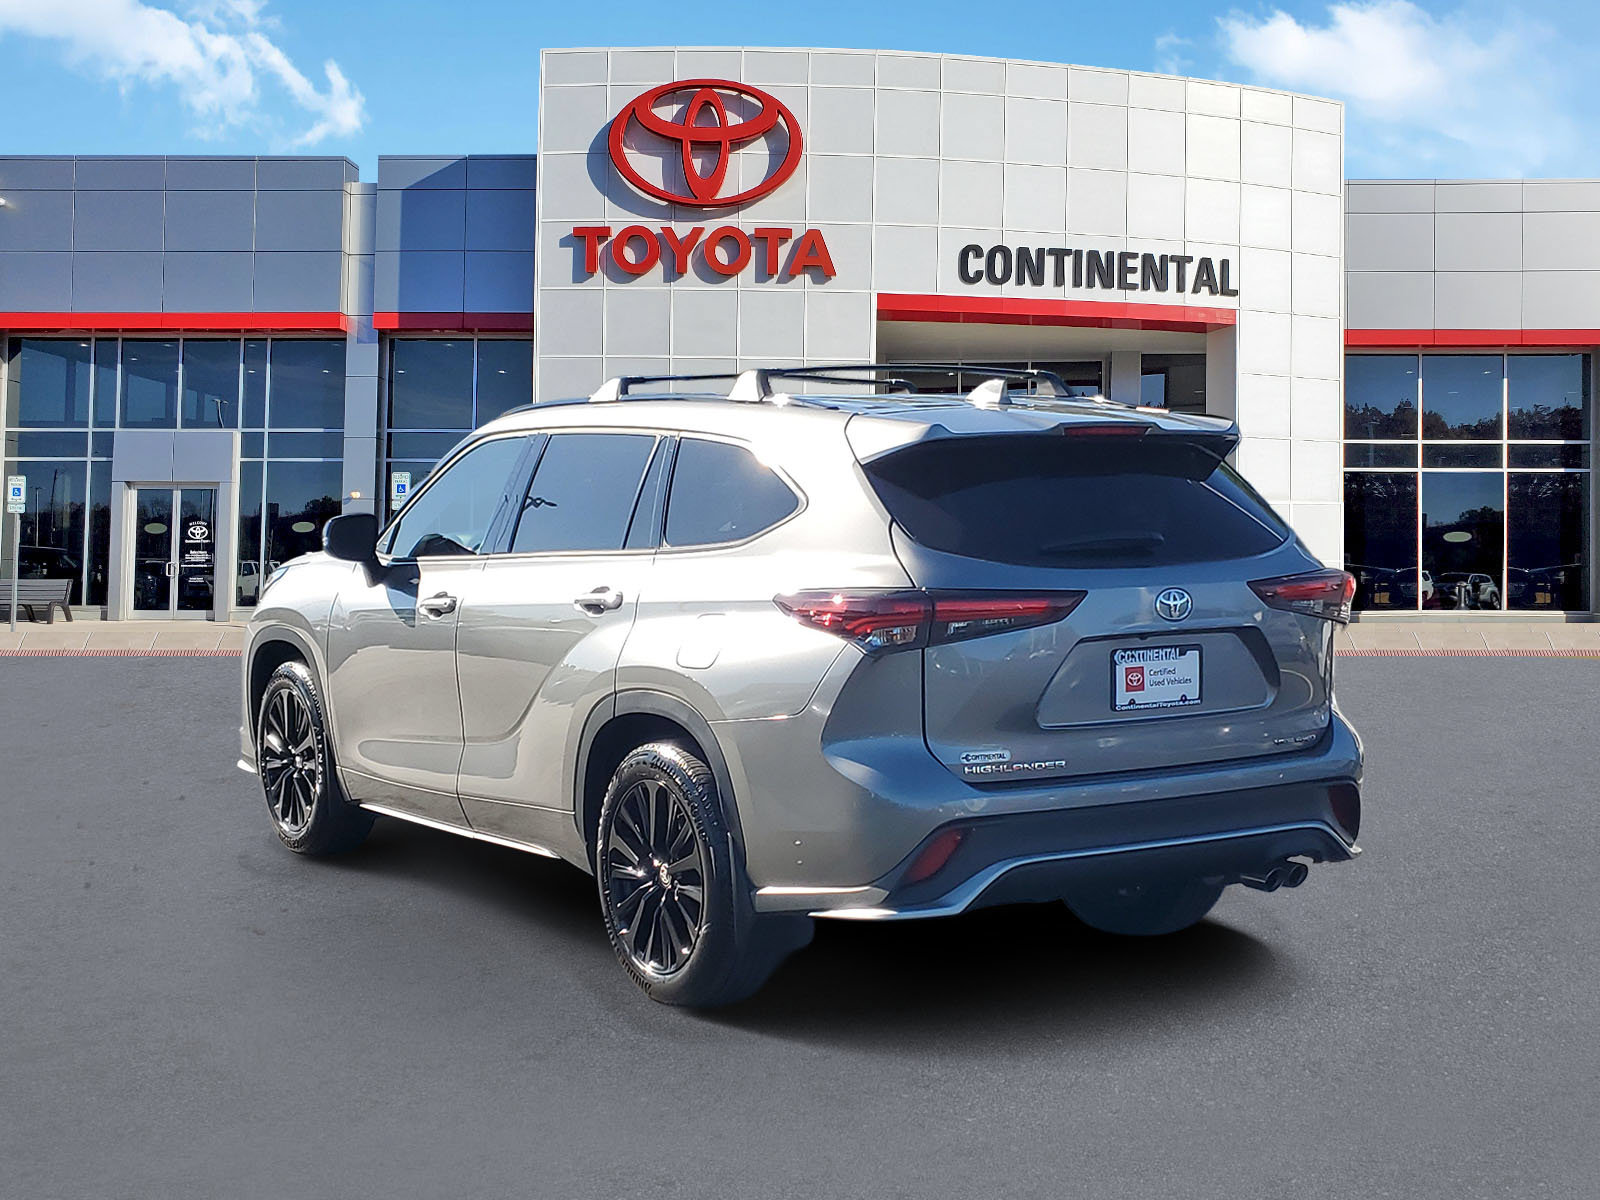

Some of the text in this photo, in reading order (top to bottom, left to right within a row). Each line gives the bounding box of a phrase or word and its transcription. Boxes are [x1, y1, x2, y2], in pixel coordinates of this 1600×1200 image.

[572, 226, 836, 278] TOYOTA
[959, 244, 1239, 297] CONTINENTAL
[1114, 648, 1180, 664] CONTINENTAL
[1149, 667, 1176, 676] Certified
[1149, 676, 1192, 687] Used Vehicles
[961, 753, 1006, 762] CONTINENTAL
[964, 760, 1066, 775] HIGHLANDER
